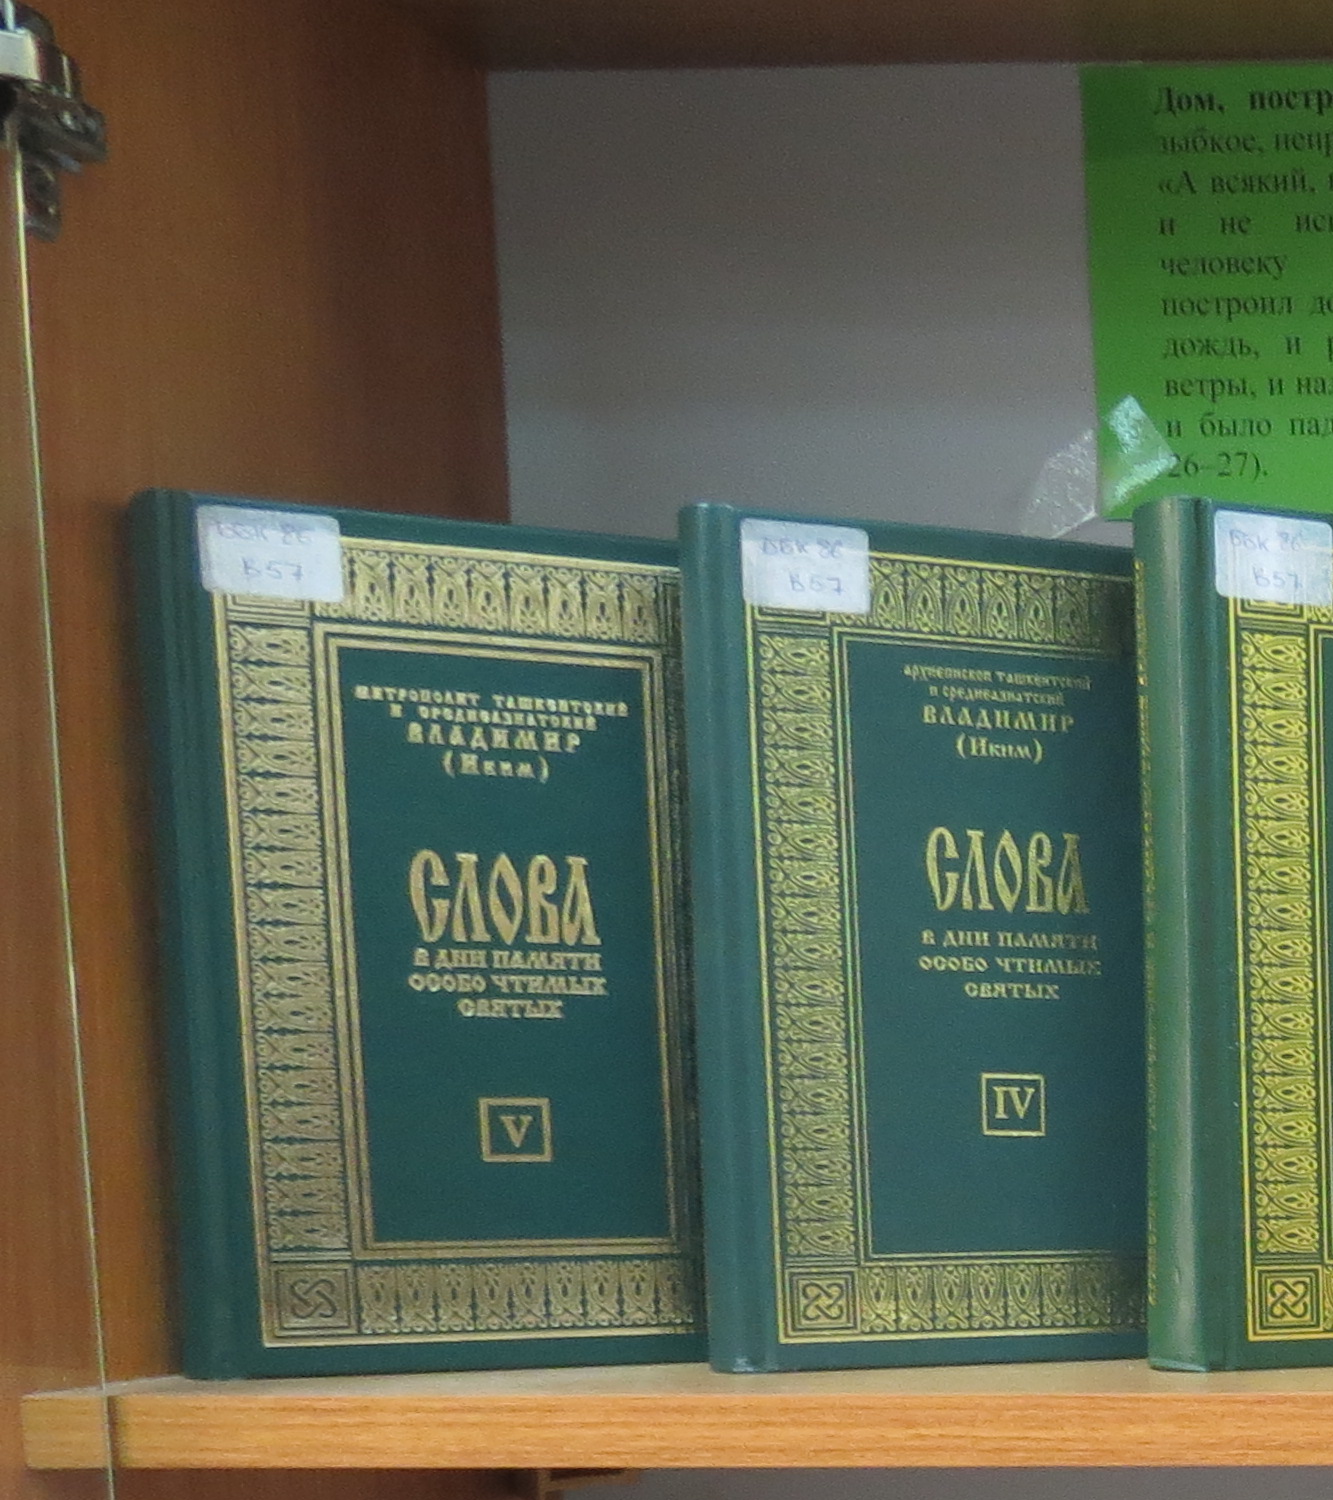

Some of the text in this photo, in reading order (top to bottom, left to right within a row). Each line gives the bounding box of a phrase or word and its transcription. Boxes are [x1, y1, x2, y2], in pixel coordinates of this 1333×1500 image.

[1154, 85, 1225, 117] Дом,
[1159, 126, 1264, 156] зыбкое,
[1158, 172, 1198, 195] «А
[1210, 165, 1316, 196] всякий,
[922, 704, 1074, 732] ВЛАДИМИР
[408, 721, 582, 755] ВЛАДИМИР
[956, 734, 1043, 763] (Иким)
[926, 826, 1089, 914] СЛОВА
[410, 848, 601, 947] СЛОВА
[921, 930, 1097, 950] В ДНИ ПАМЯТИ
[415, 948, 602, 971] В ДНИ ПАМЯТИ
[919, 955, 1101, 976] ОСОБО ЧТИМЫХ
[409, 973, 608, 996] ОСОБО ЧТИМЫХ
[965, 979, 1060, 999] СВЯТЫХ
[458, 998, 564, 1019] СВЯТЫХ
[993, 1085, 1034, 1119] IV
[501, 1115, 532, 1147] V
